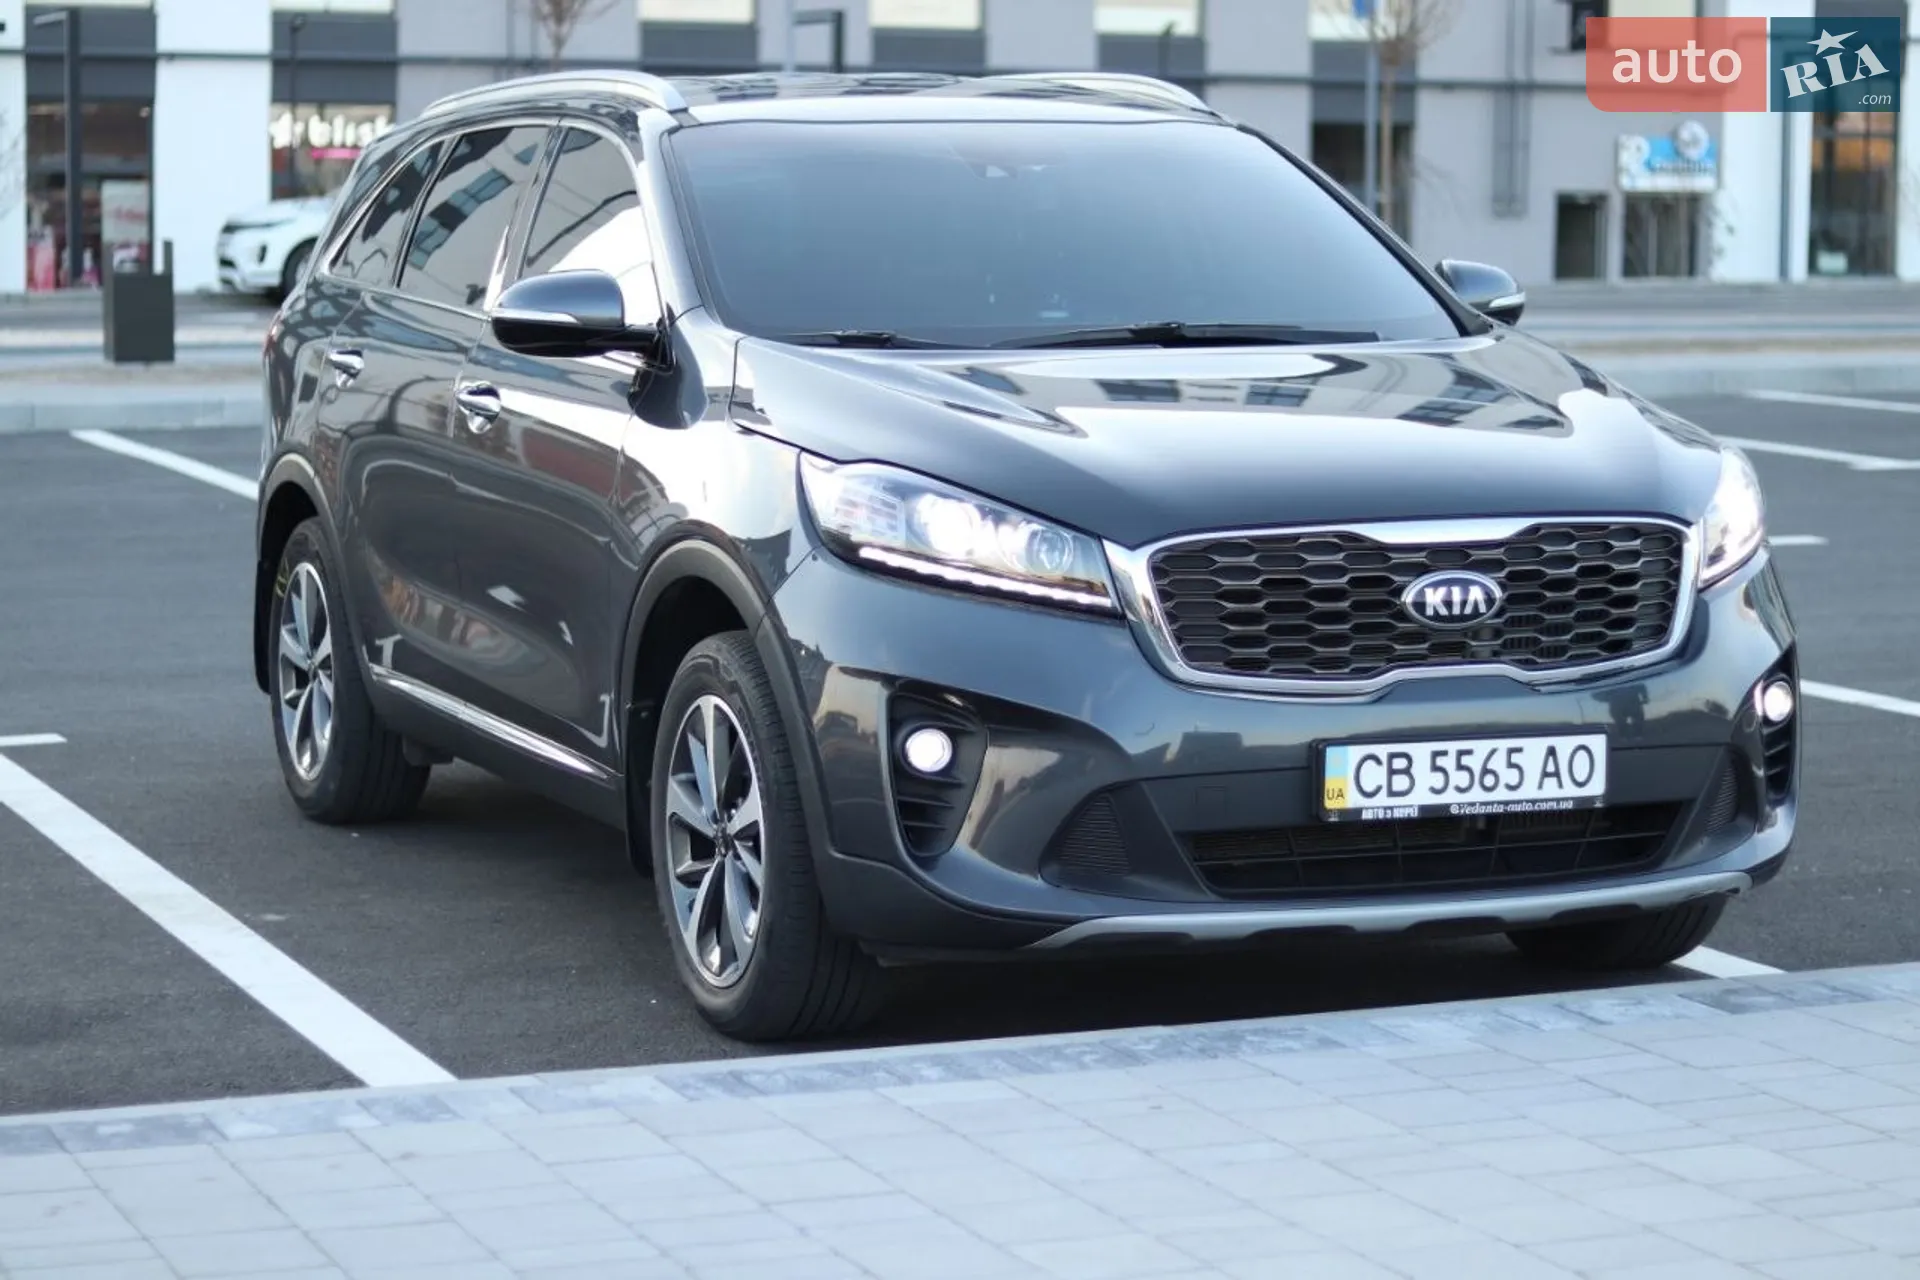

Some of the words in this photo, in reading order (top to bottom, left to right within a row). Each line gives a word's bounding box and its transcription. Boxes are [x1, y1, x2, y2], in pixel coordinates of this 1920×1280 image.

[1424, 585, 1487, 616] KIA
[1353, 751, 1416, 799] CB
[1428, 746, 1525, 795] 5565
[1537, 744, 1596, 791] AO
[1326, 787, 1346, 801] UA
